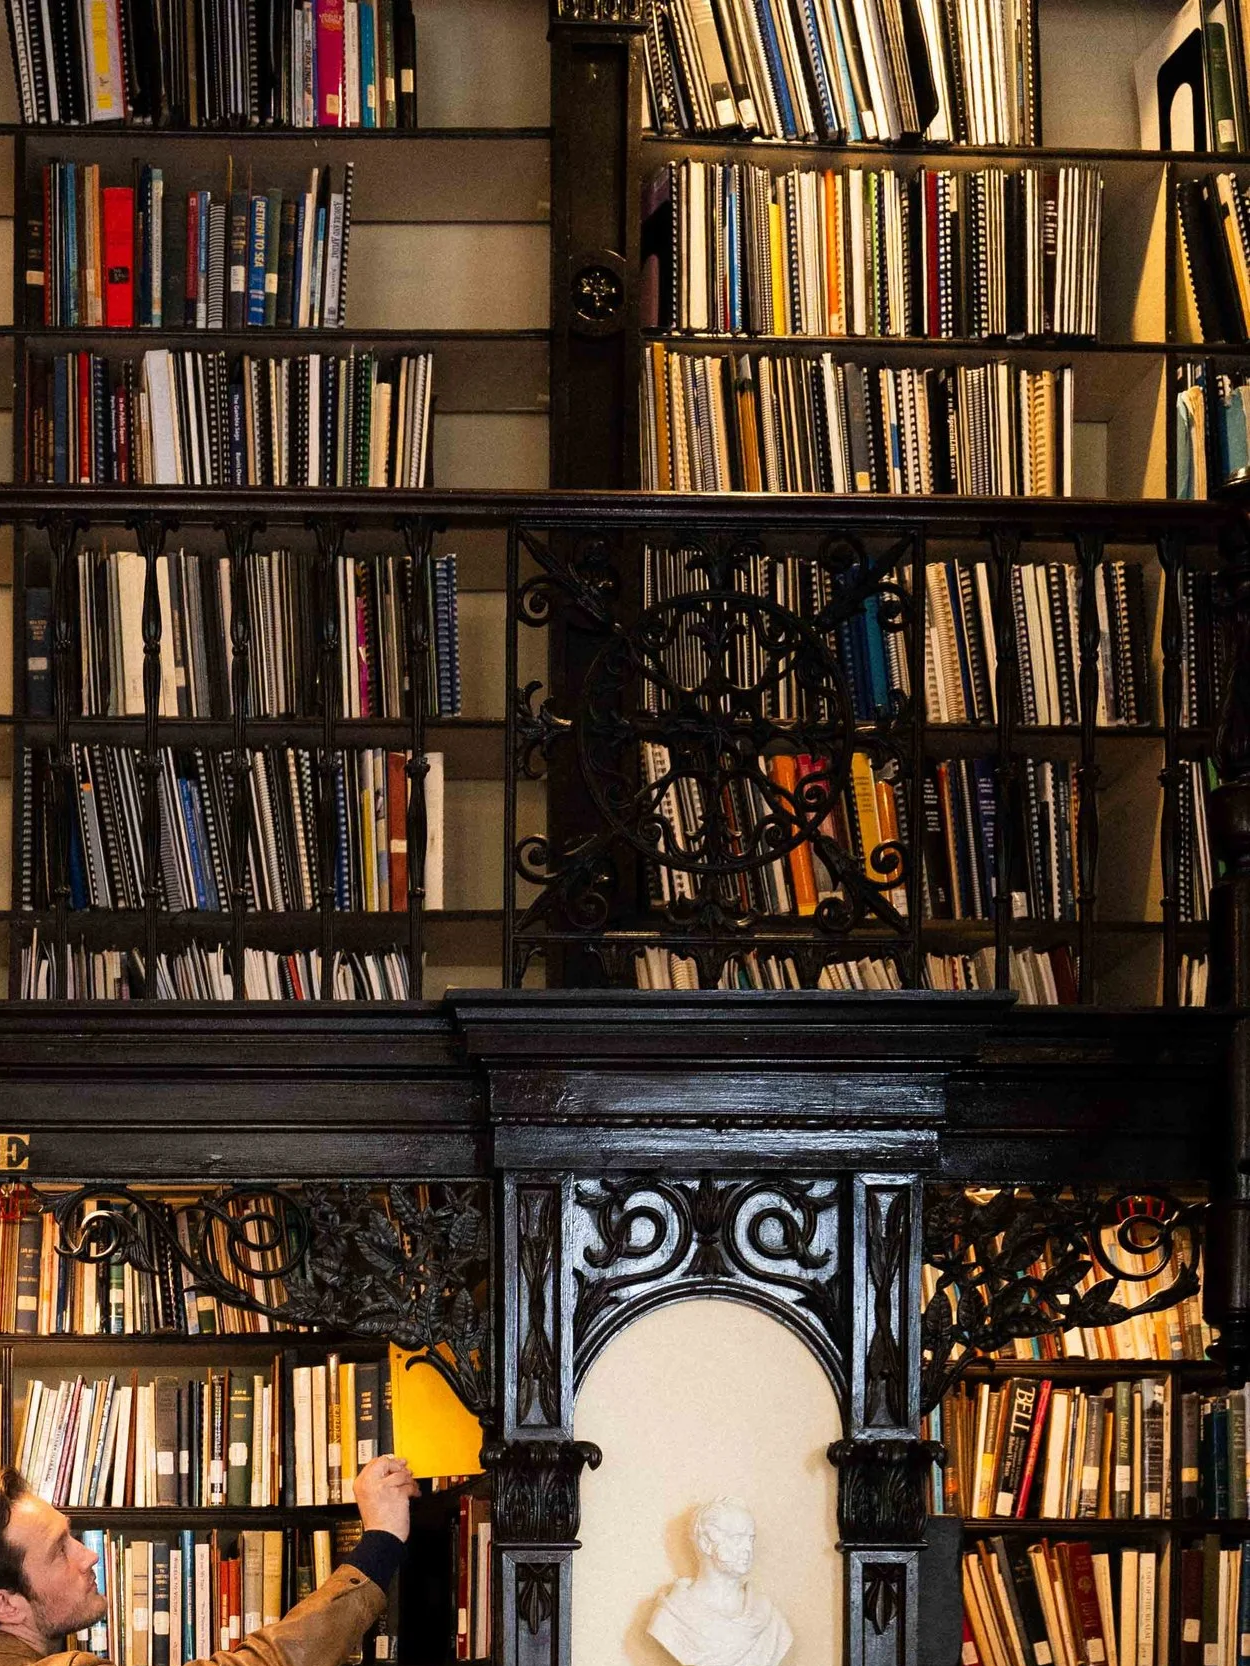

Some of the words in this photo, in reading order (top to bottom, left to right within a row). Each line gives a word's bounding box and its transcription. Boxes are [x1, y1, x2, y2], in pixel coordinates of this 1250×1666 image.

[304, 39, 312, 82] SPEAKING
[304, 83, 312, 95] UP
[255, 200, 266, 236] RETURN
[254, 238, 265, 250] TO
[254, 252, 265, 267] SEA
[1010, 1386, 1036, 1434] BELL
[1120, 1415, 1129, 1440] Mabel
[1120, 1442, 1128, 1458] Bell
